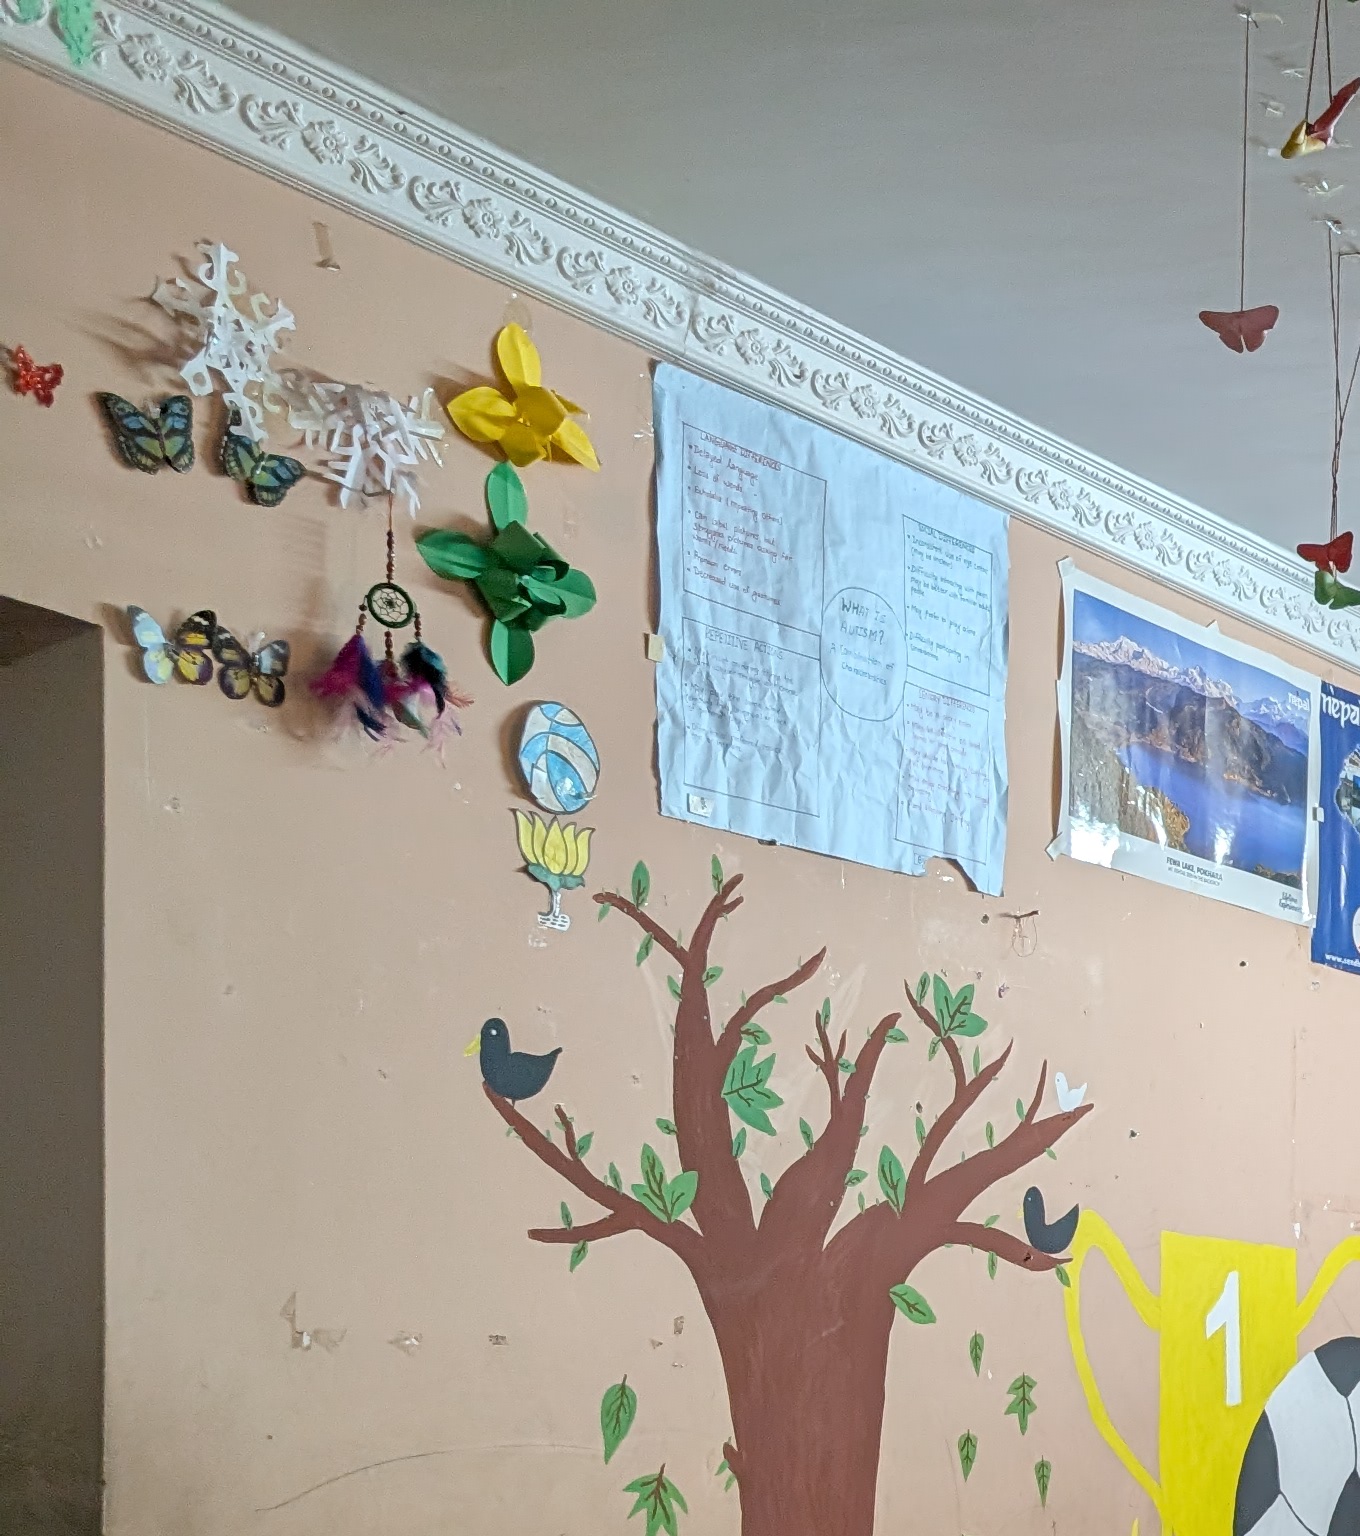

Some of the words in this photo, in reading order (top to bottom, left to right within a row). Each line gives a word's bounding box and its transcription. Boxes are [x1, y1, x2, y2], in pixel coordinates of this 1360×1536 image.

[842, 597, 869, 617] WHAT
[875, 610, 887, 624] IS
[841, 620, 884, 645] AUTISM?
[1205, 1270, 1242, 1406] 1
